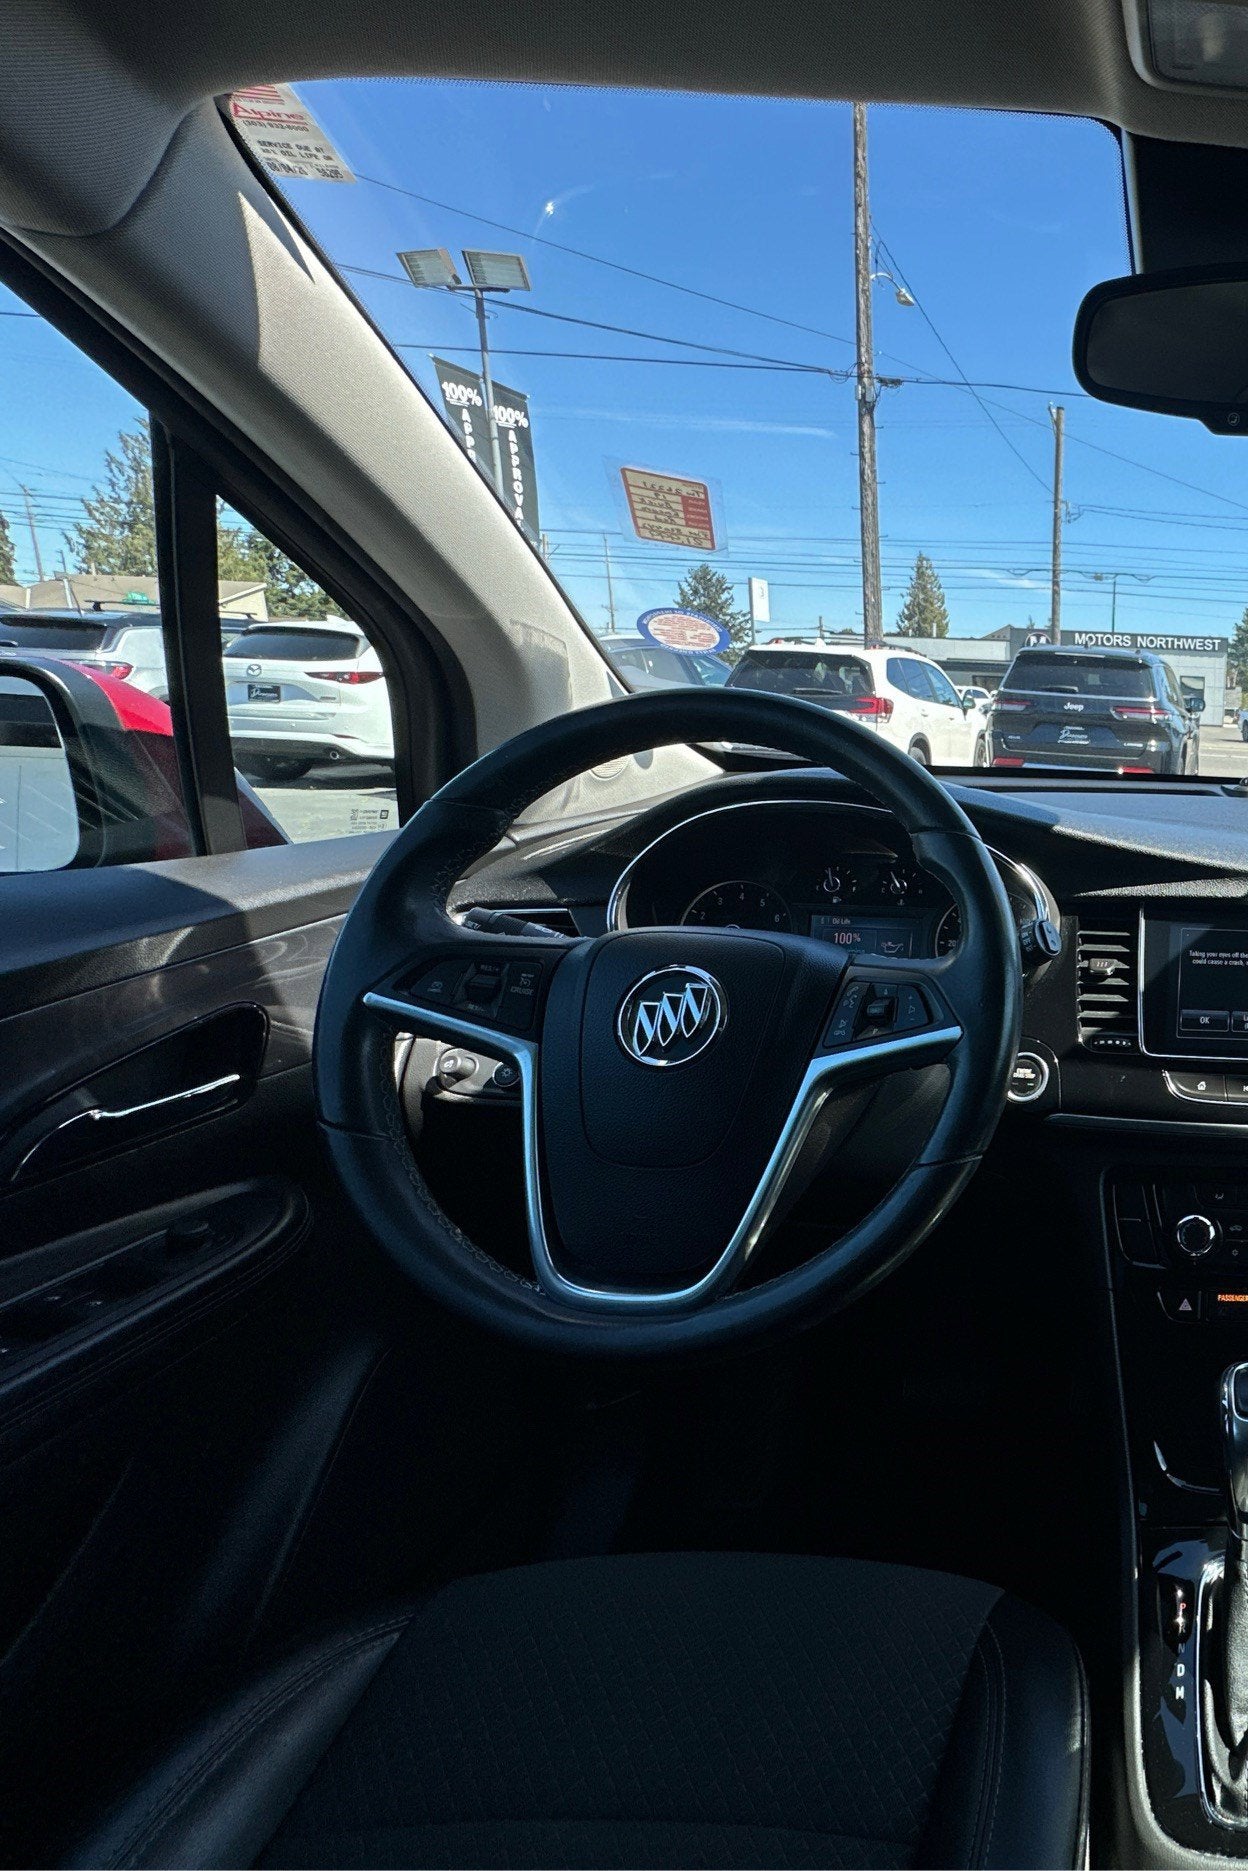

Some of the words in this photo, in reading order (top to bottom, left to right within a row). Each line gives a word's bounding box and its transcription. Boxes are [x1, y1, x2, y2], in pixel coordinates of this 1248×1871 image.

[442, 382, 482, 406] 100%
[493, 405, 529, 428] 100%
[1074, 633, 1131, 647] MOTORS
[1137, 636, 1221, 651] NORTHWEST
[1063, 702, 1084, 712] Jeep
[760, 899, 766, 907] 5
[774, 914, 780, 922] 6
[833, 932, 861, 944] 100%
[1189, 950, 1205, 958] Taking
[1200, 1016, 1210, 1024] OK
[1217, 1294, 1248, 1302] PASSENGER
[1178, 1643, 1185, 1653] N
[1177, 1663, 1185, 1677] D
[1175, 1686, 1184, 1699] M
